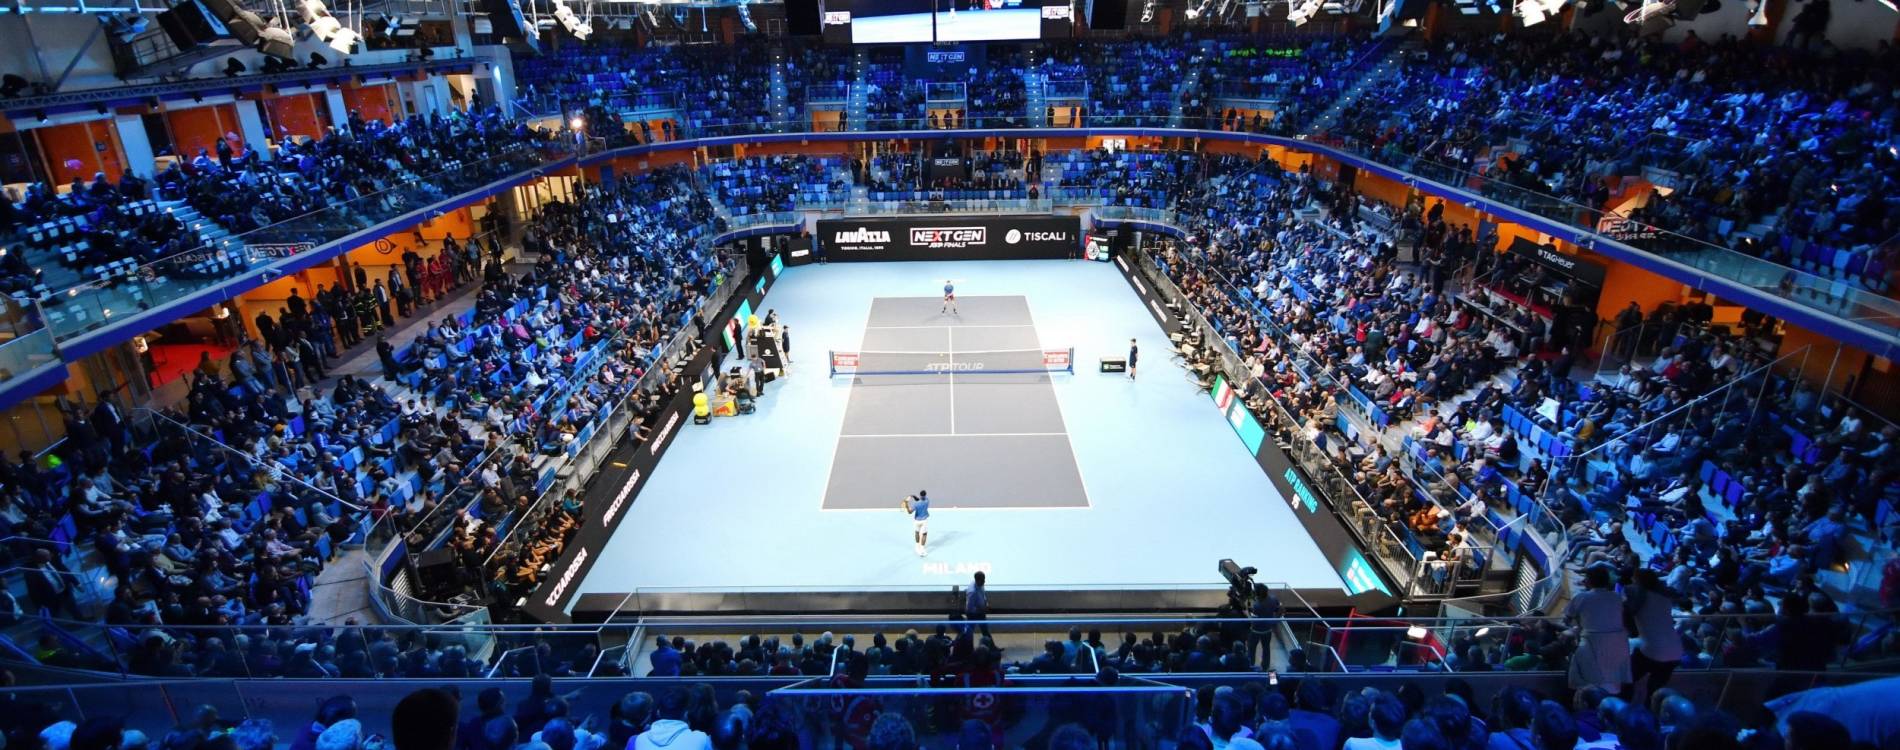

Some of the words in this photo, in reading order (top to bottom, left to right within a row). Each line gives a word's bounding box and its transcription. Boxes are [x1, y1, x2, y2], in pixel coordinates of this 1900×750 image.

[835, 227, 891, 243] LAVAZZA
[914, 231, 952, 242] NEXT
[953, 231, 982, 241] GEN
[1024, 231, 1066, 241] TISCALI
[1294, 478, 1318, 514] RANKING
